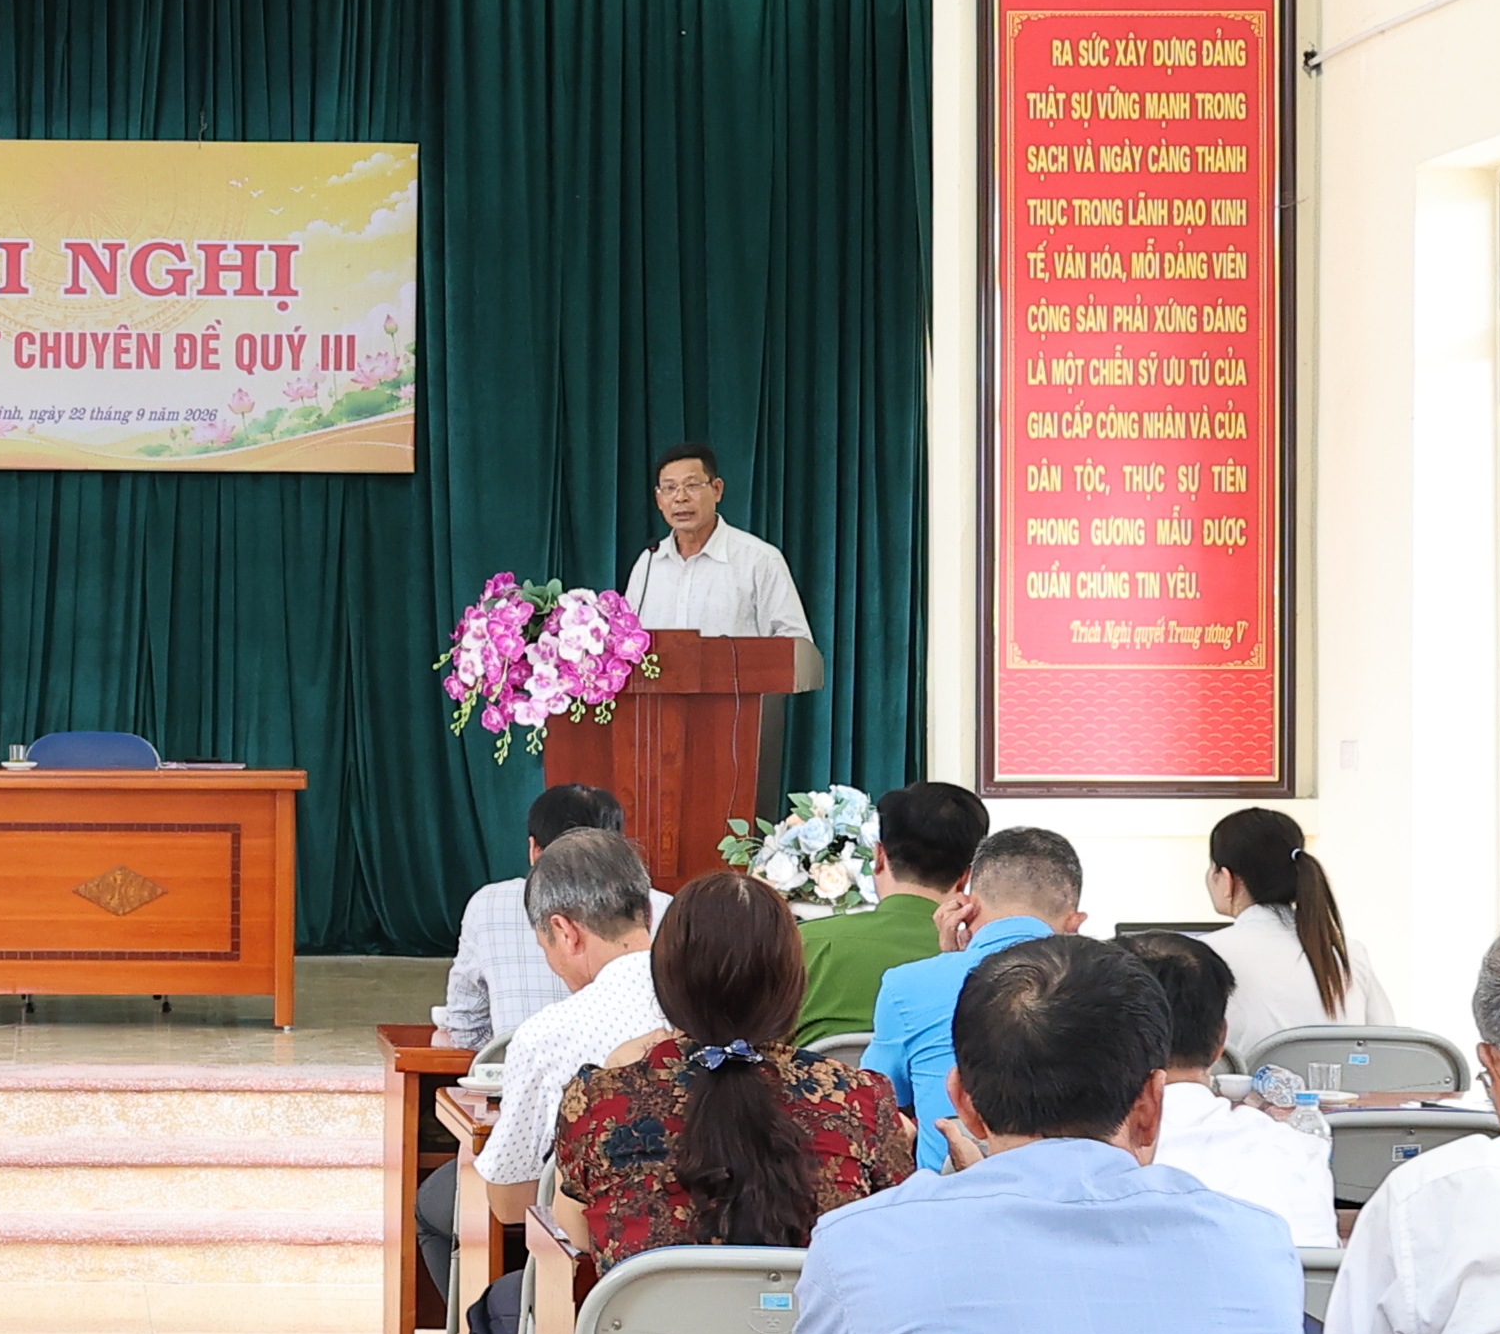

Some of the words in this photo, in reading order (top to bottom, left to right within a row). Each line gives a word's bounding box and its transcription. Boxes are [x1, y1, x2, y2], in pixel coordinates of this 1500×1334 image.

[1052, 39, 1074, 67] RA
[1078, 31, 1110, 67] SỨC
[1114, 31, 1148, 67] XÂY
[1152, 36, 1197, 75] DỰNG
[1201, 27, 1247, 67] ĐẢNG
[1026, 84, 1067, 128] THẬT
[1070, 89, 1093, 129] SỰ
[1096, 85, 1140, 120] VỮNG
[1144, 92, 1191, 128] MẠNH
[1194, 92, 1247, 120] TRONG
[1027, 145, 1069, 182] SẠCH
[1072, 138, 1096, 173] VÀ
[1099, 138, 1143, 173] NGÀY
[1147, 138, 1191, 173] CÀNG
[1194, 138, 1247, 173] THÀNH
[63, 241, 300, 313] NGHỊ
[1026, 240, 1050, 283] TẾ,
[1053, 244, 1087, 279] VĂN
[1090, 244, 1127, 283] HÓA,
[1131, 238, 1160, 280] MỖI
[1163, 240, 1208, 280] ĐẢNG
[1211, 244, 1247, 280] VIÊN
[1027, 297, 1071, 341] CỘNG
[1075, 293, 1108, 333] SẢN
[1113, 293, 1148, 332] PHẢI
[1153, 297, 1198, 333] XỨNG
[1202, 298, 1247, 333] ĐÁNG
[14, 325, 162, 371] CHUYÊN
[173, 319, 222, 373] ĐỀ
[234, 325, 306, 376] QUÝ
[320, 334, 357, 373] III
[28, 407, 65, 424] ngày
[68, 407, 86, 421] 22
[90, 407, 133, 425] tháng
[136, 408, 145, 422] 9
[149, 408, 180, 422] năm
[184, 408, 218, 422] 2026
[1027, 457, 1062, 492] DÂN
[1073, 457, 1110, 501] TỘC,
[1122, 462, 1165, 501] THỰC
[1177, 462, 1201, 501] SỰ
[1211, 457, 1247, 493] TIÊN
[1027, 518, 1080, 546] PHONG
[1090, 515, 1145, 546] GƯƠNG
[1156, 505, 1192, 546] MẪU
[1203, 515, 1247, 555] ĐƯỢC
[1026, 560, 1071, 599] QUẦN
[1076, 565, 1130, 599] CHÚNG
[1135, 571, 1160, 599] TIN
[1166, 564, 1201, 599] YÊU.
[1103, 620, 1132, 649] Nghị
[1168, 620, 1202, 649] Trung
